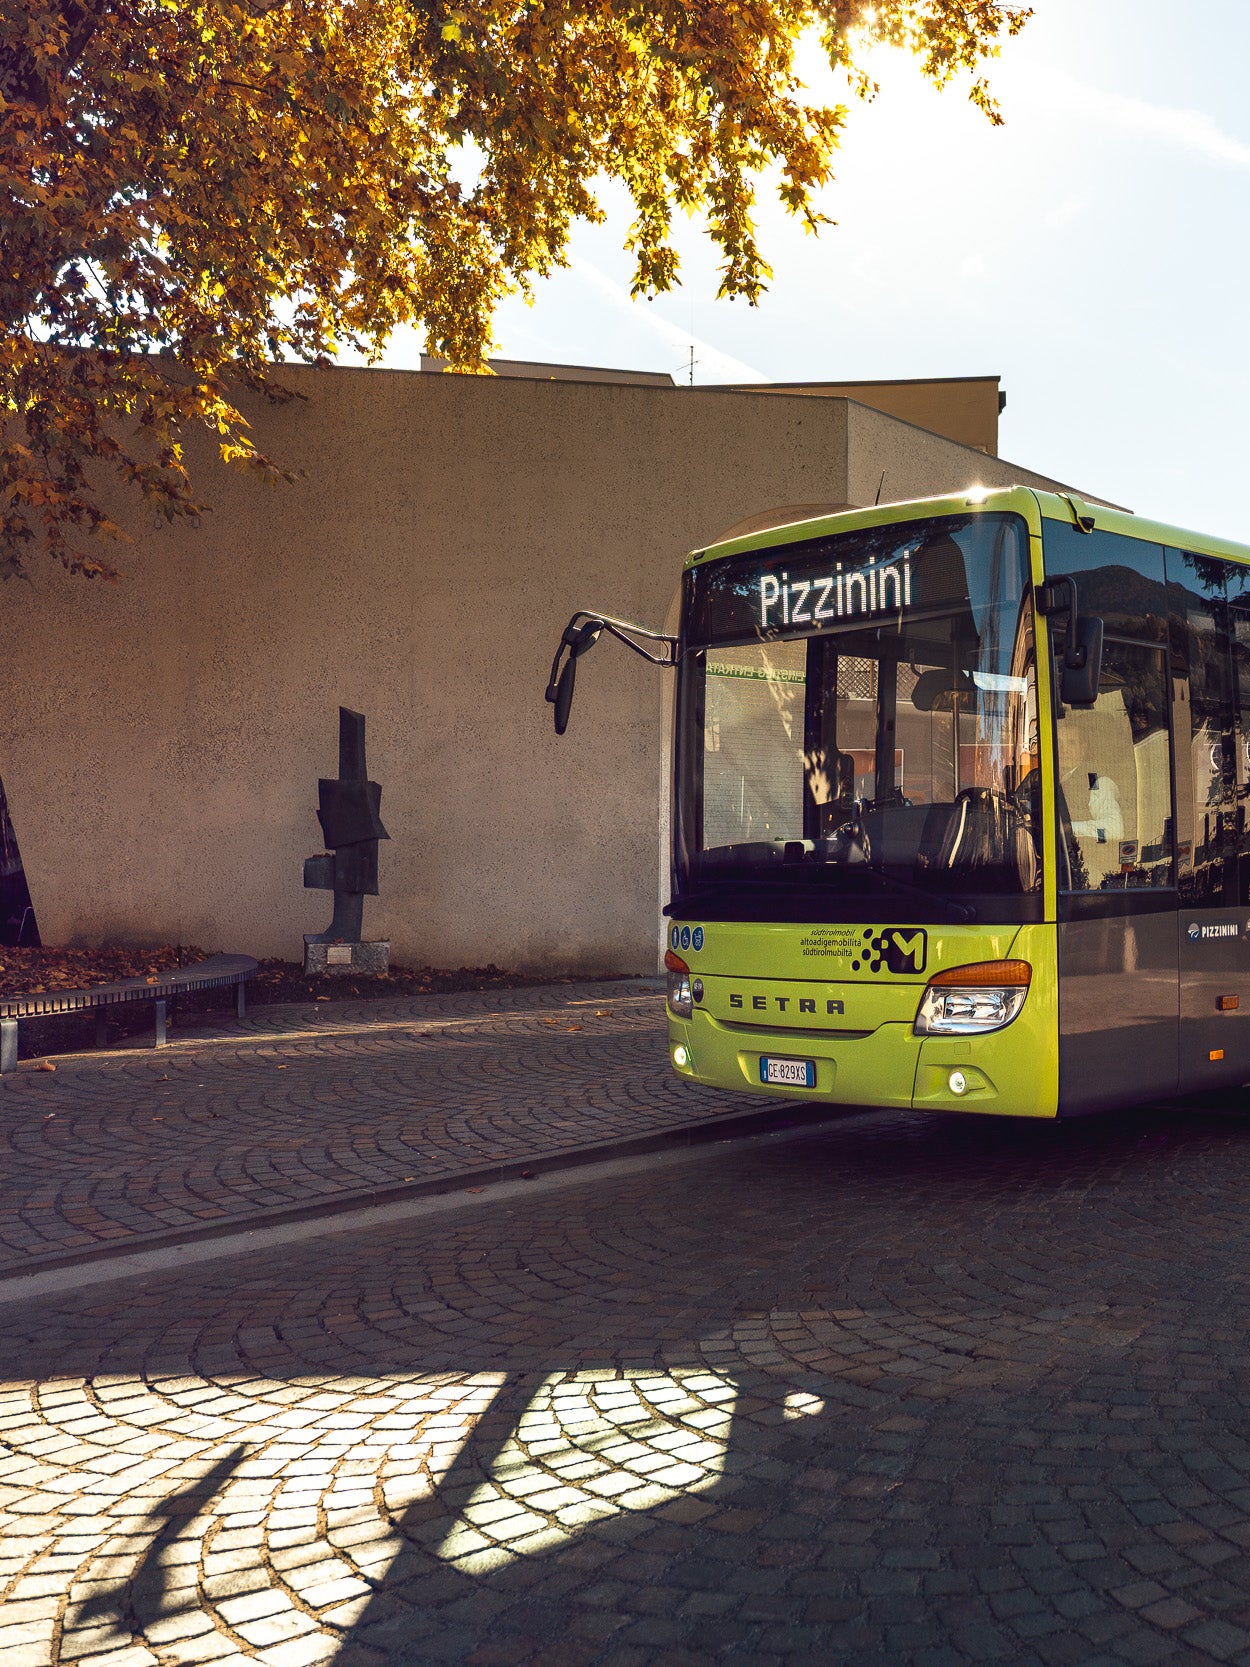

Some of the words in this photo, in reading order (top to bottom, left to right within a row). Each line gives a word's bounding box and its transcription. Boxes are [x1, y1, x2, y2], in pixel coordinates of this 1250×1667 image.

[761, 551, 912, 627] Pizzinini
[810, 928, 857, 937] südtirolmobil
[1201, 924, 1239, 939] PIZZININI
[799, 937, 862, 948] altoadigemobilità
[729, 994, 845, 1014] SETRA
